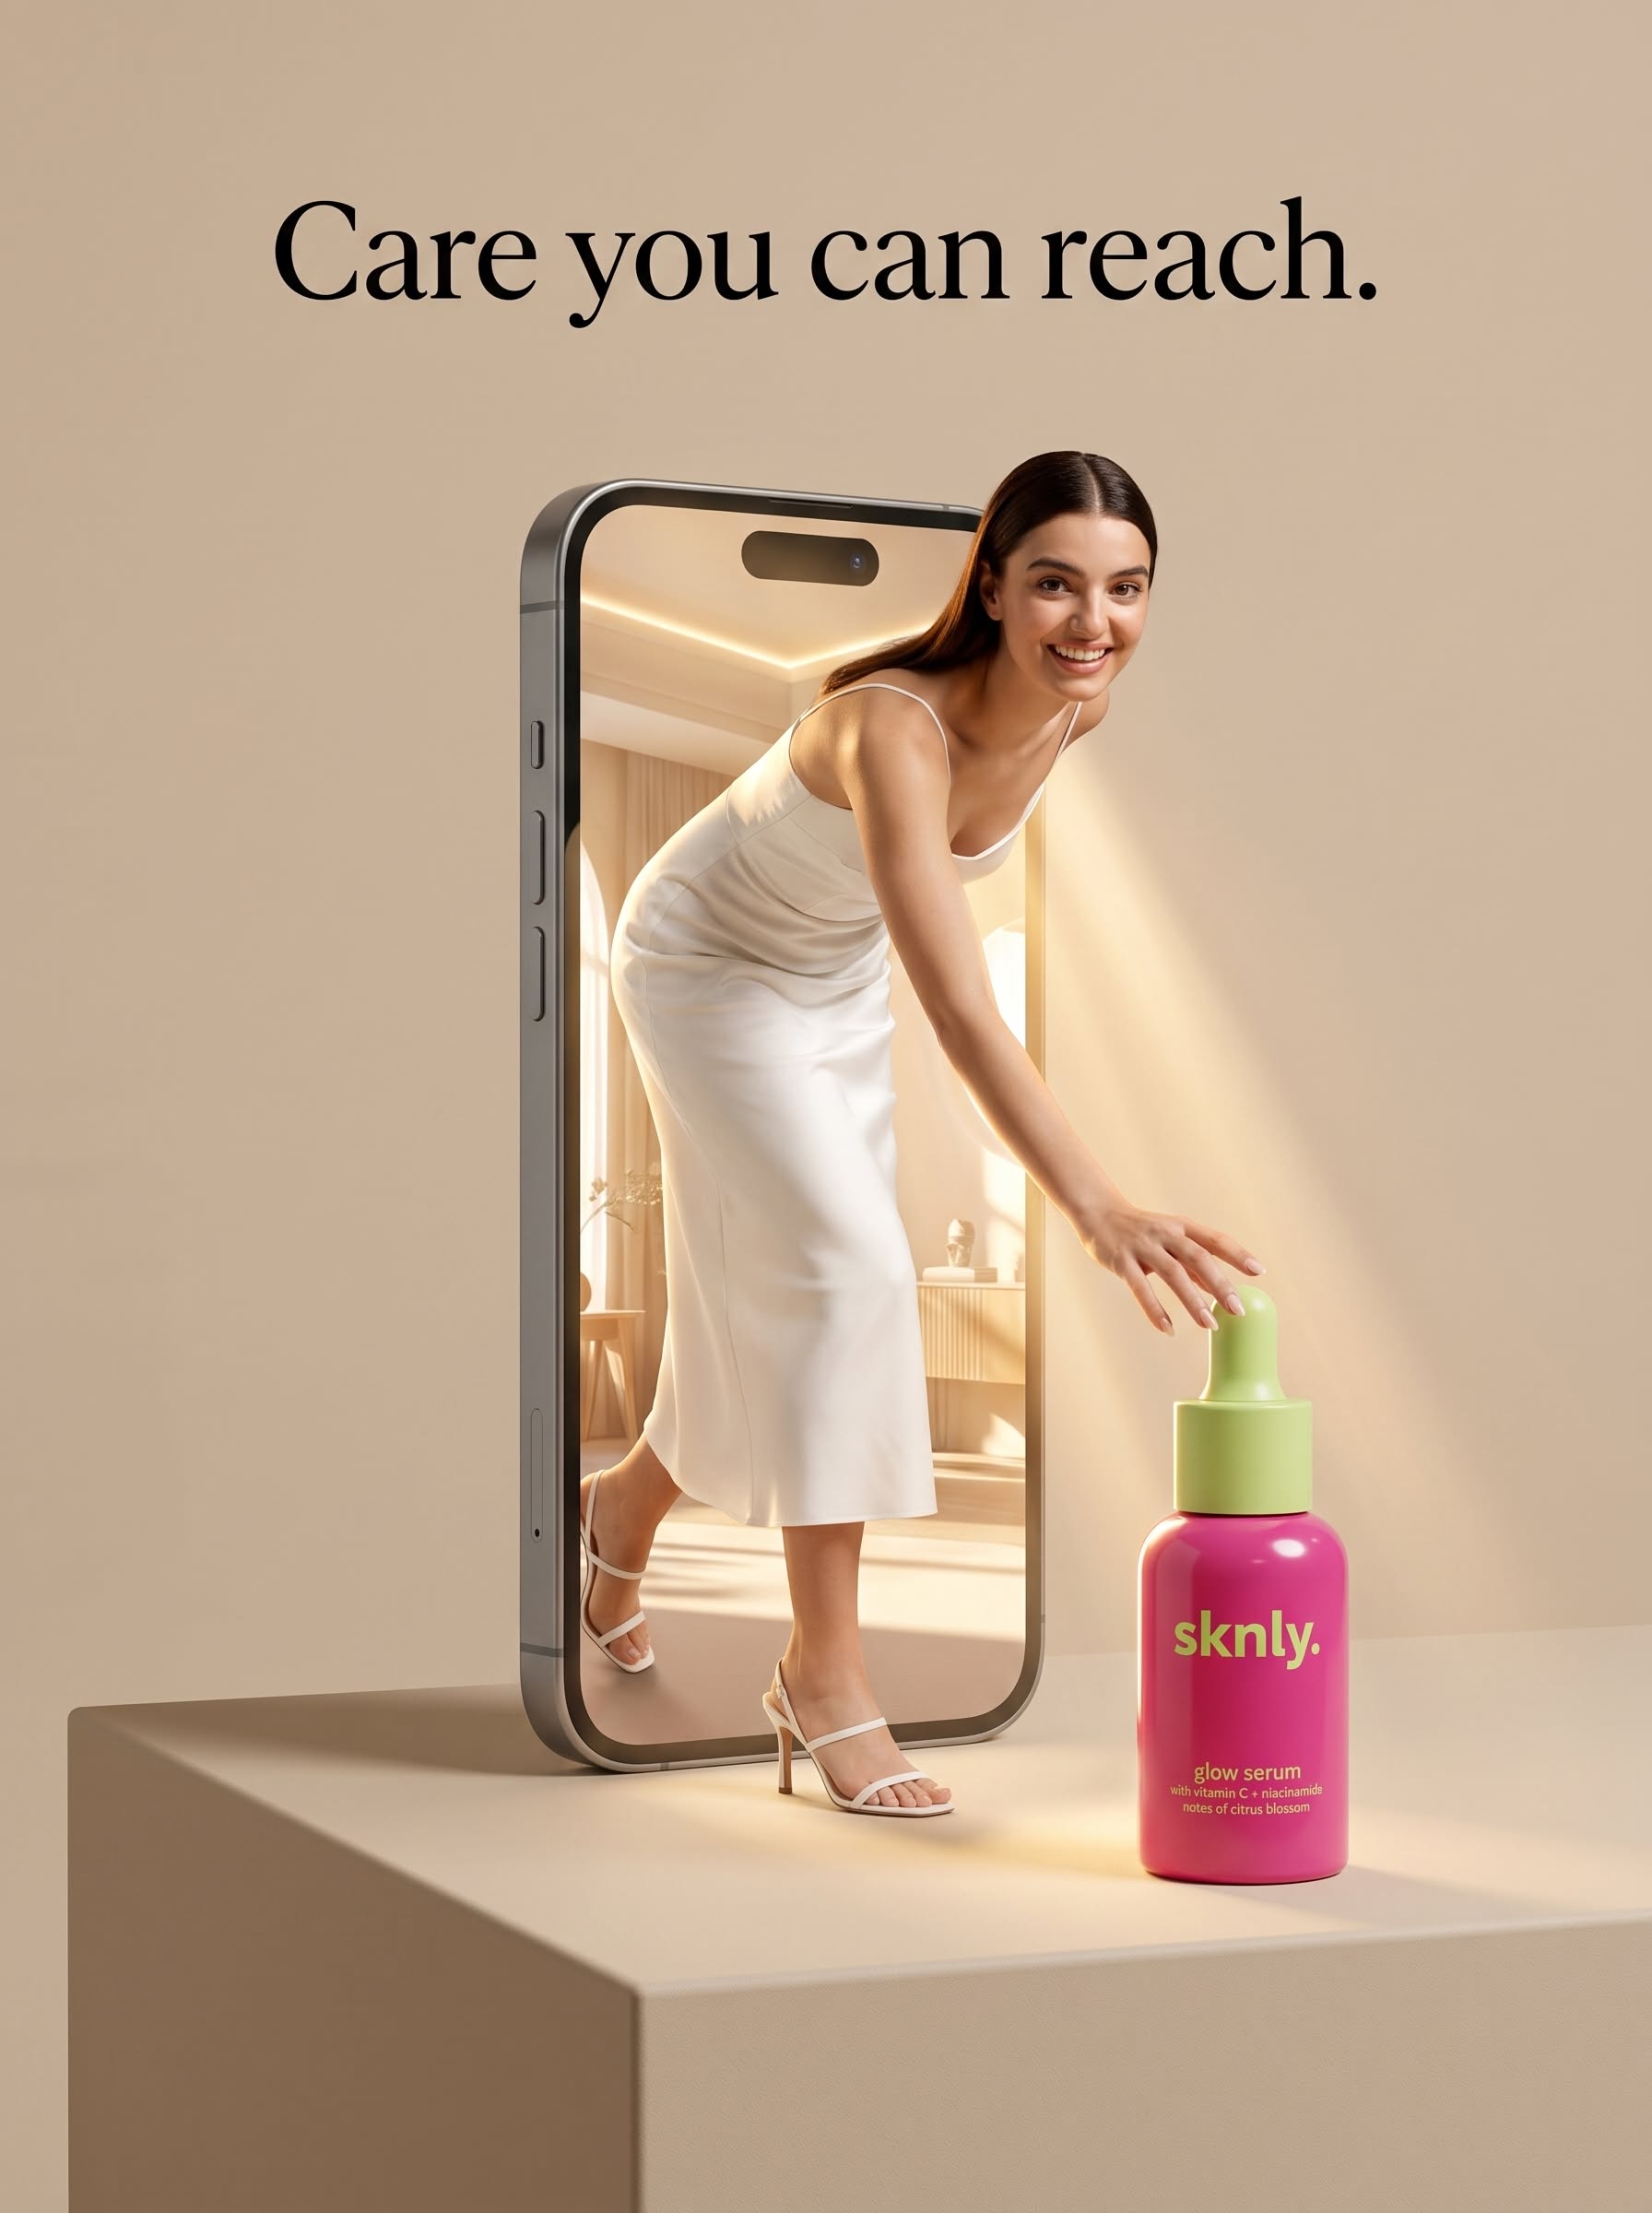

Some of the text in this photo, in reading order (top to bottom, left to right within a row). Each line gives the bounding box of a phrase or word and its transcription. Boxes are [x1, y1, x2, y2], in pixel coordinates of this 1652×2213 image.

[1174, 1609, 1320, 1670] sknly.
[1194, 1762, 1301, 1784] glow serum
[1170, 1784, 1191, 1797] with
[1194, 1786, 1236, 1799] vitamin
[1239, 1787, 1248, 1799] C
[1262, 1783, 1323, 1799] niacinamide
[1183, 1802, 1310, 1815] notes of citrus blossom
